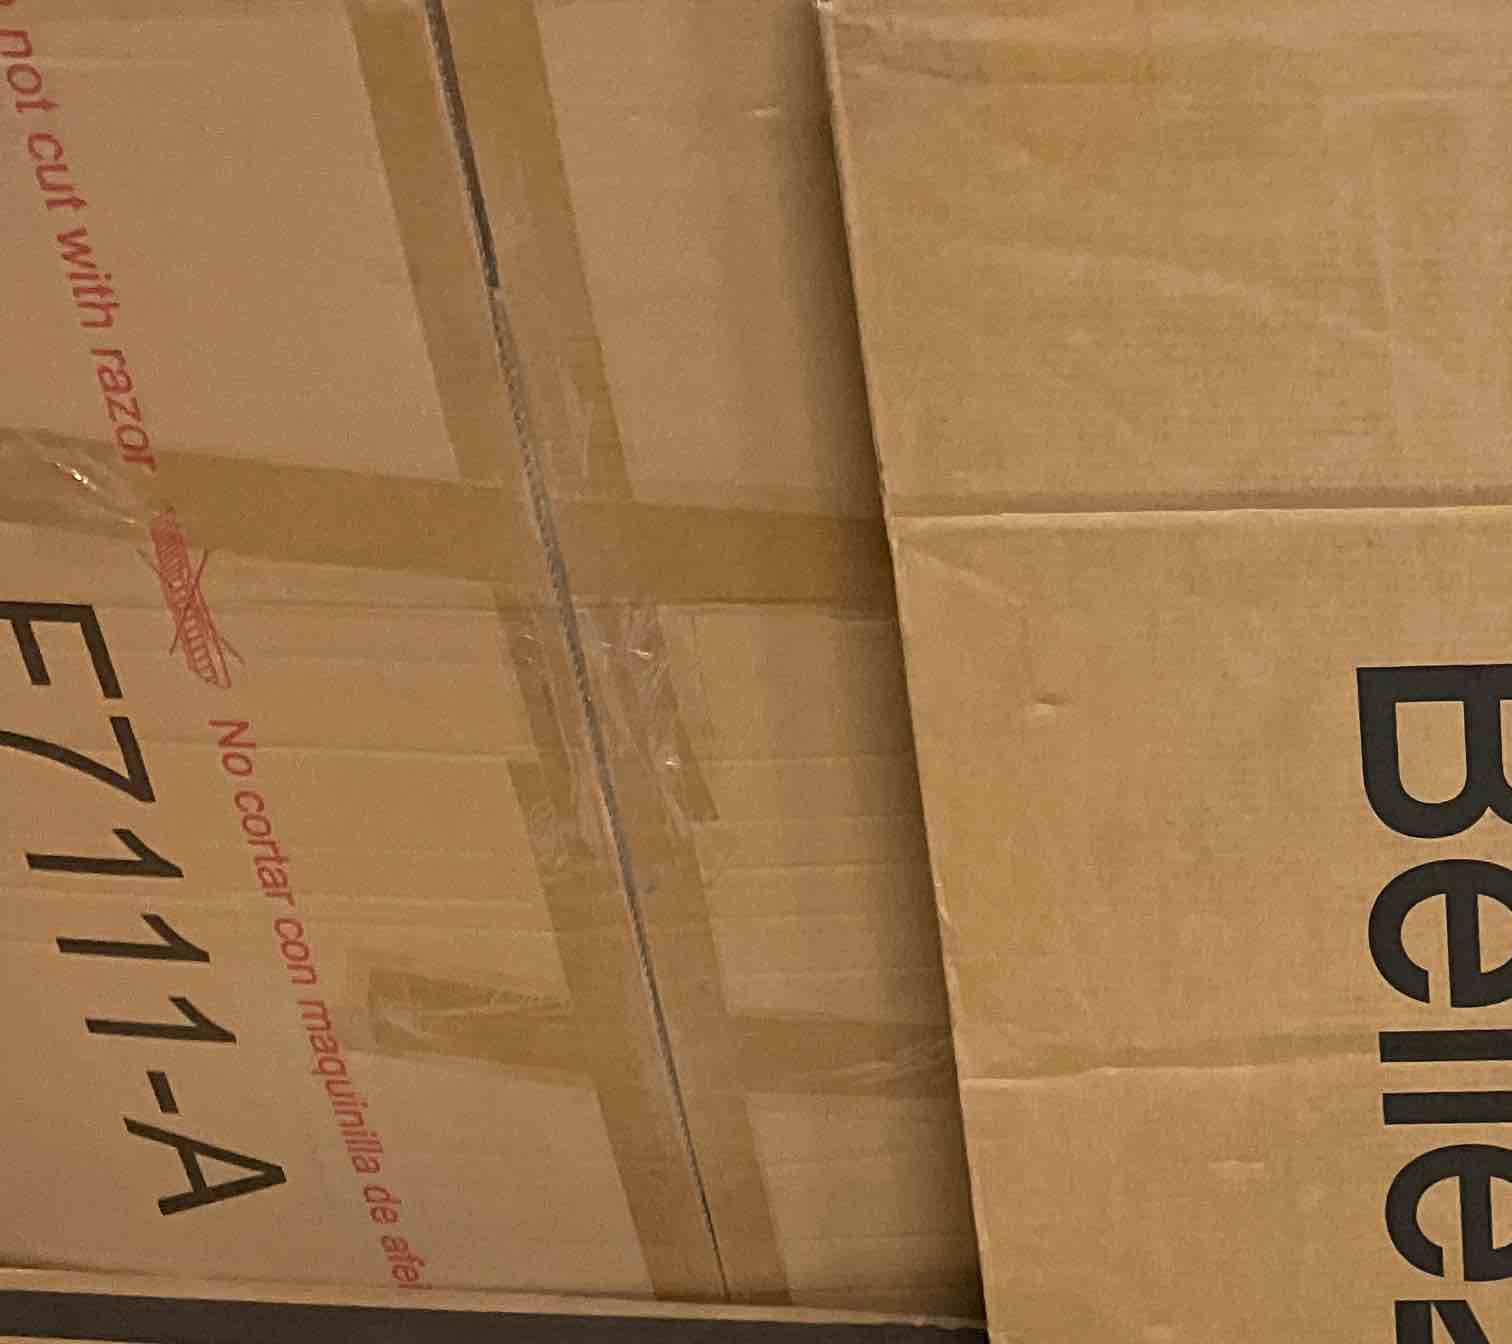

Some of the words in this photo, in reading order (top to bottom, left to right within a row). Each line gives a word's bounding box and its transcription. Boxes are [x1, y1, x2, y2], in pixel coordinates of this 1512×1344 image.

[0, 27, 58, 114] not
[27, 131, 87, 212] cut
[57, 226, 119, 328] with
[90, 346, 157, 472] razor
[208, 717, 254, 777] No
[234, 789, 294, 906] cortar
[274, 915, 319, 986] con
[296, 997, 386, 1174] maquinilla
[363, 1183, 402, 1225] de
